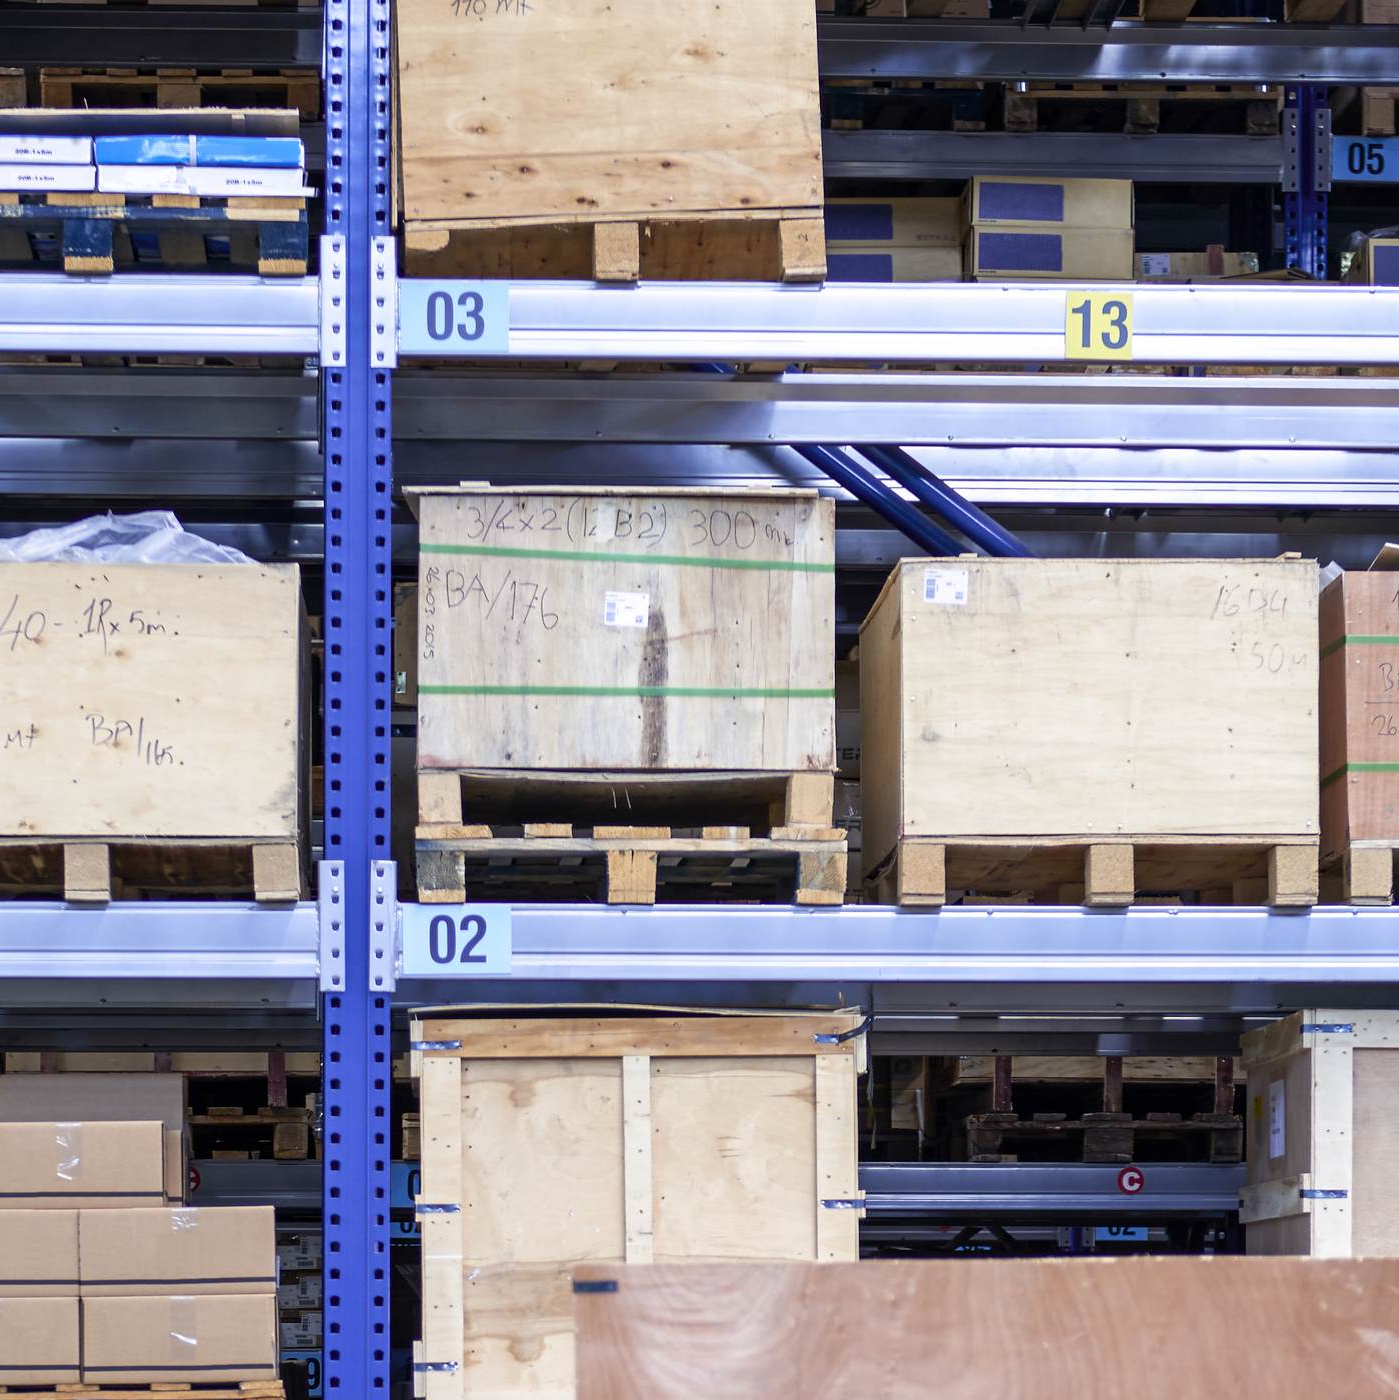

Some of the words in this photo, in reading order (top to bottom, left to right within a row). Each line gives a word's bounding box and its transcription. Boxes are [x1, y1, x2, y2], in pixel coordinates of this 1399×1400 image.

[1347, 143, 1385, 175] 05
[426, 292, 486, 341] 03
[1070, 301, 1129, 349] 13
[691, 510, 755, 548] 300
[446, 569, 558, 630] BA/176
[429, 915, 487, 963] 02
